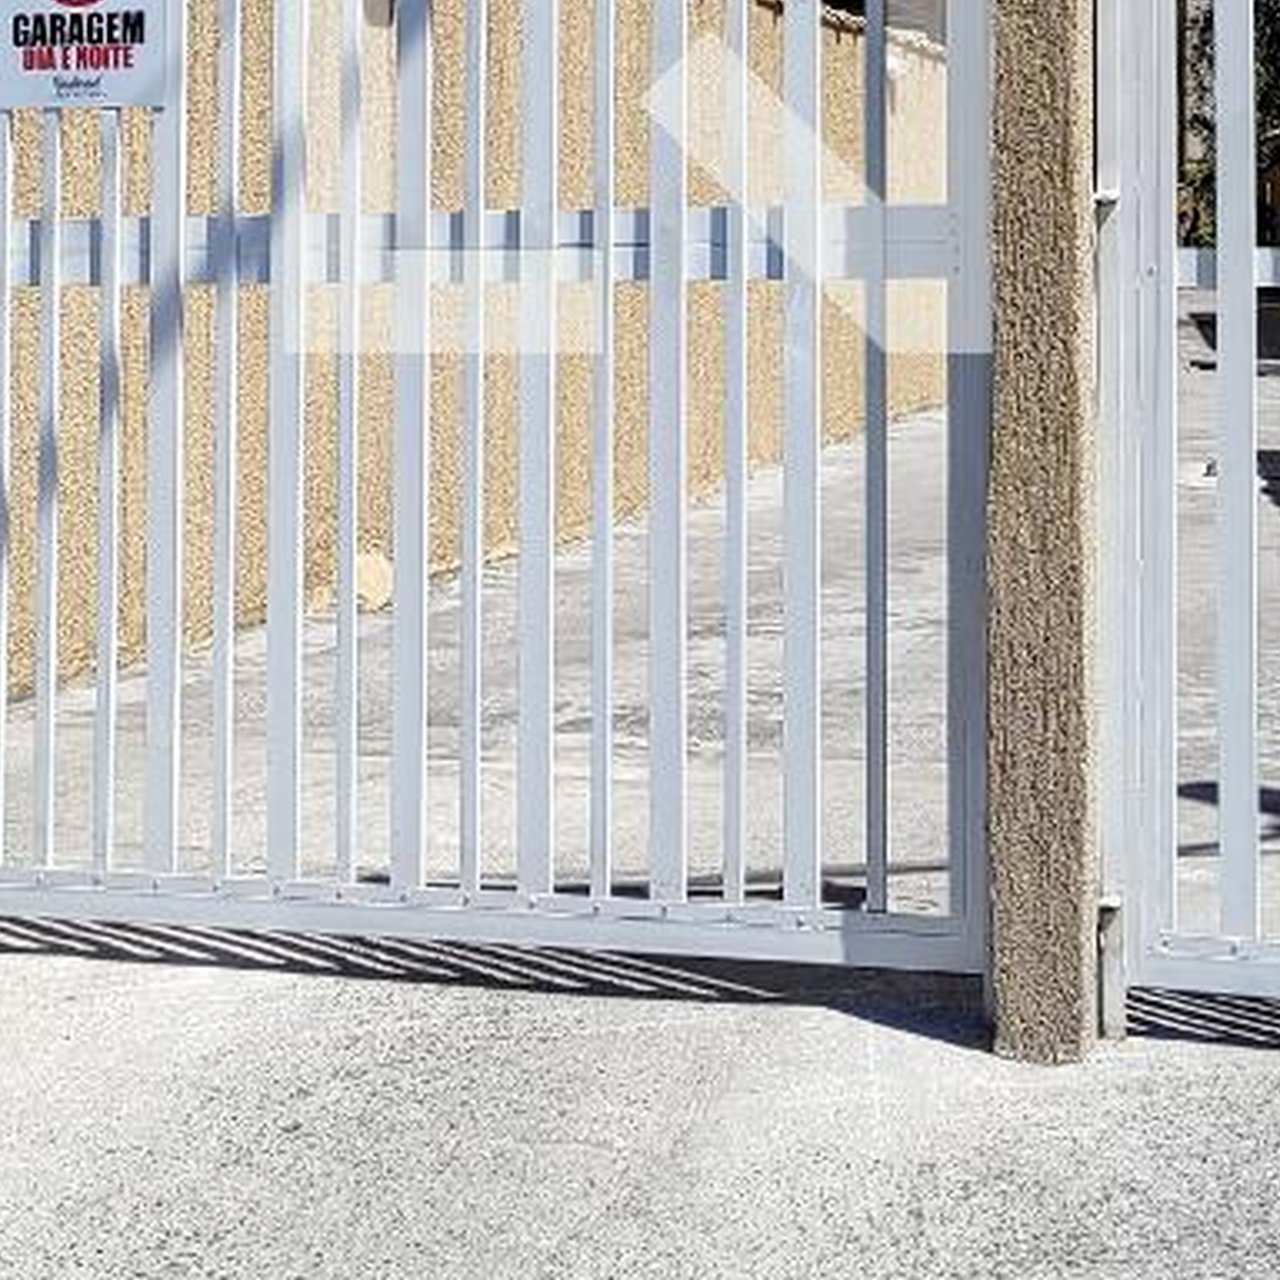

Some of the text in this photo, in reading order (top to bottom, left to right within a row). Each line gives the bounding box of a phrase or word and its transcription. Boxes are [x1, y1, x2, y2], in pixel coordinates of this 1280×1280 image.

[12, 10, 146, 48] GARAGEM
[22, 45, 135, 72] DIA E NOITE
